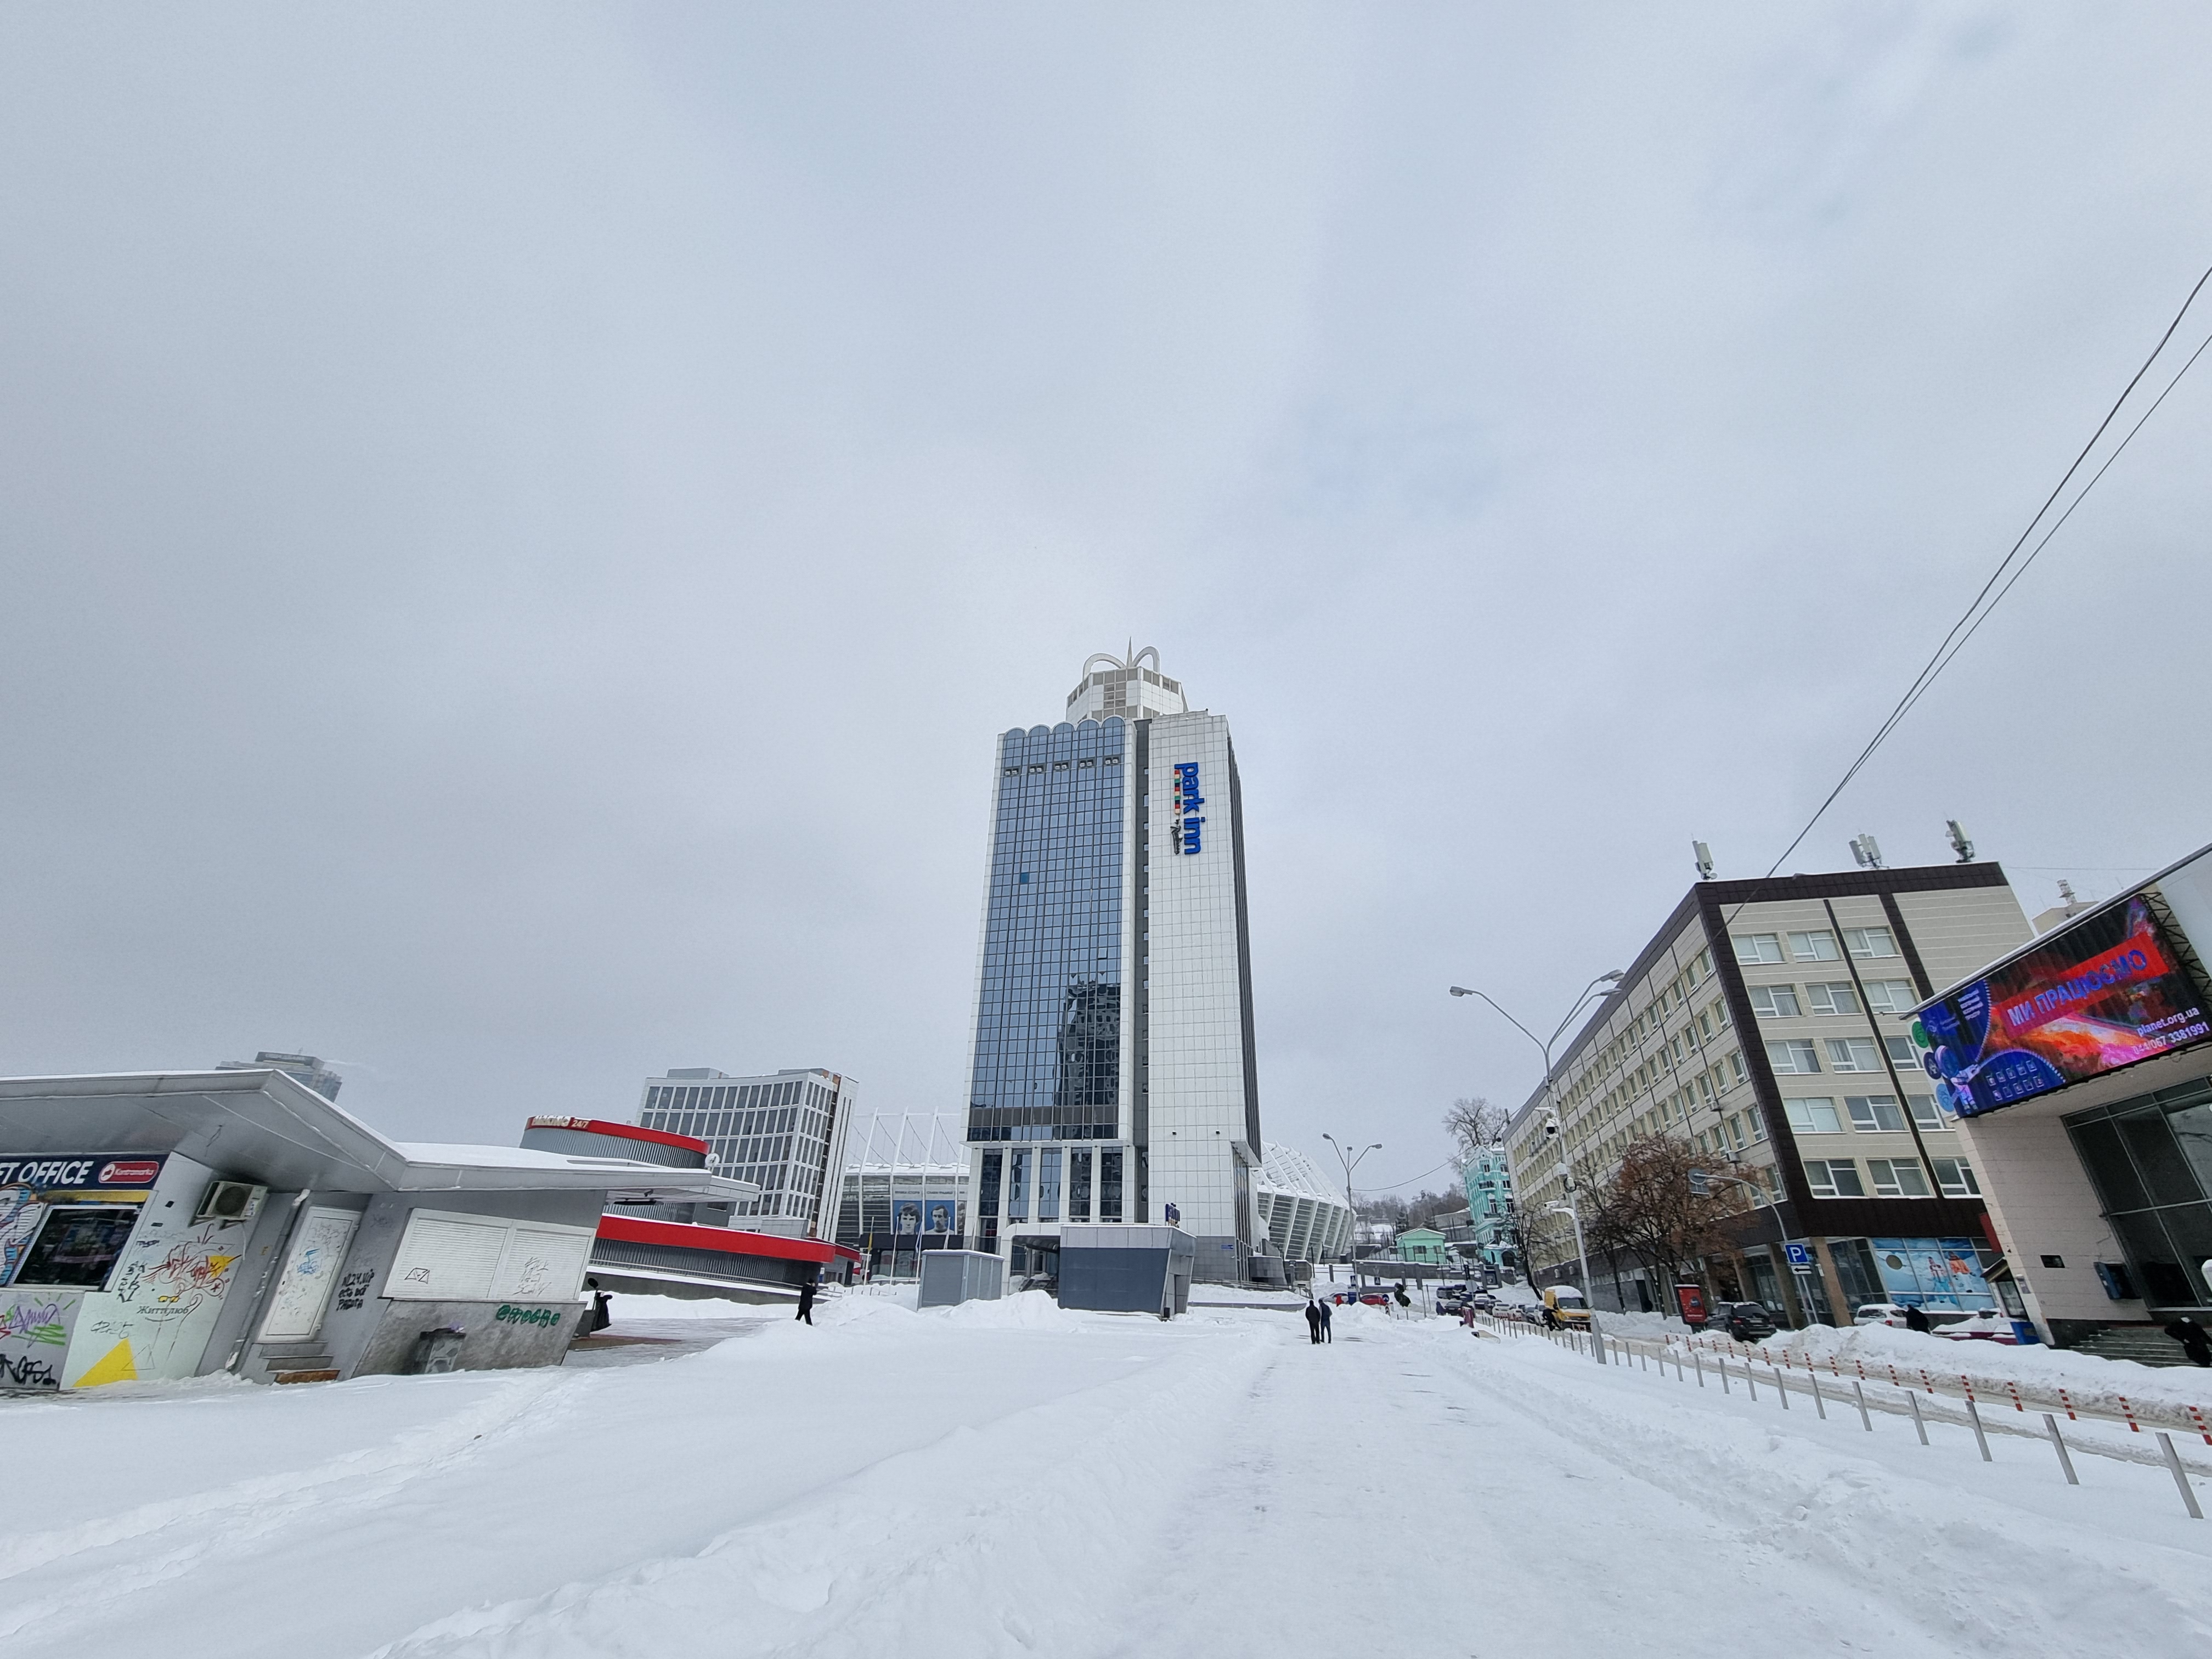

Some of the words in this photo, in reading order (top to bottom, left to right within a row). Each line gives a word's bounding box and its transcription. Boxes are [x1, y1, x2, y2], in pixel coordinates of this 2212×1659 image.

[1174, 761, 1205, 815] park
[1183, 816, 1206, 855] inn
[2007, 1001, 2036, 1026] МИ
[2034, 949, 2148, 1014] ПРАЦЮЄМО
[2137, 1007, 2200, 1037] planet.org.ua
[2168, 1021, 2210, 1043] 3381991
[18, 1161, 94, 1184] OFFICE
[1790, 1246, 1802, 1262] P
